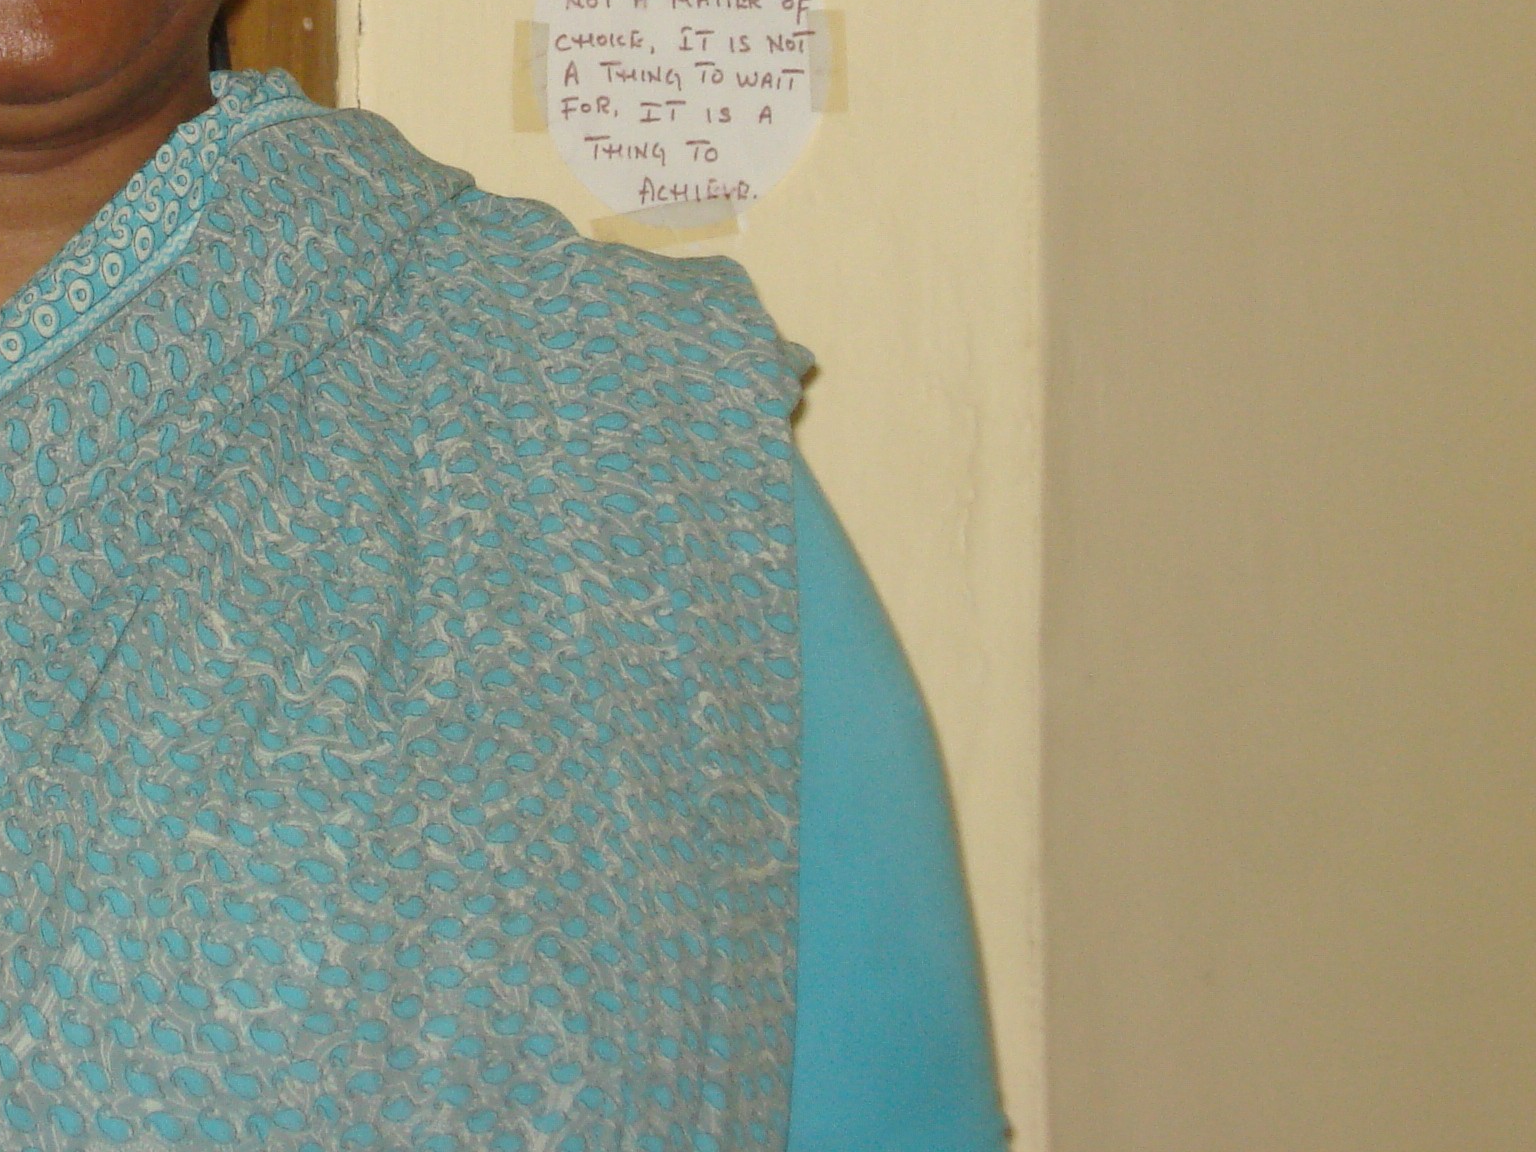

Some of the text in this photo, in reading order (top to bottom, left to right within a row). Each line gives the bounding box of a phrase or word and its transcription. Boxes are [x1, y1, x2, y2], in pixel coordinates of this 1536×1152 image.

[678, 25, 716, 52] IT
[728, 35, 753, 54] IS
[766, 29, 817, 55] NOT
[563, 60, 806, 92] A THING TO WAIT
[639, 99, 773, 126] IT IS A
[583, 135, 719, 167] THING TO
